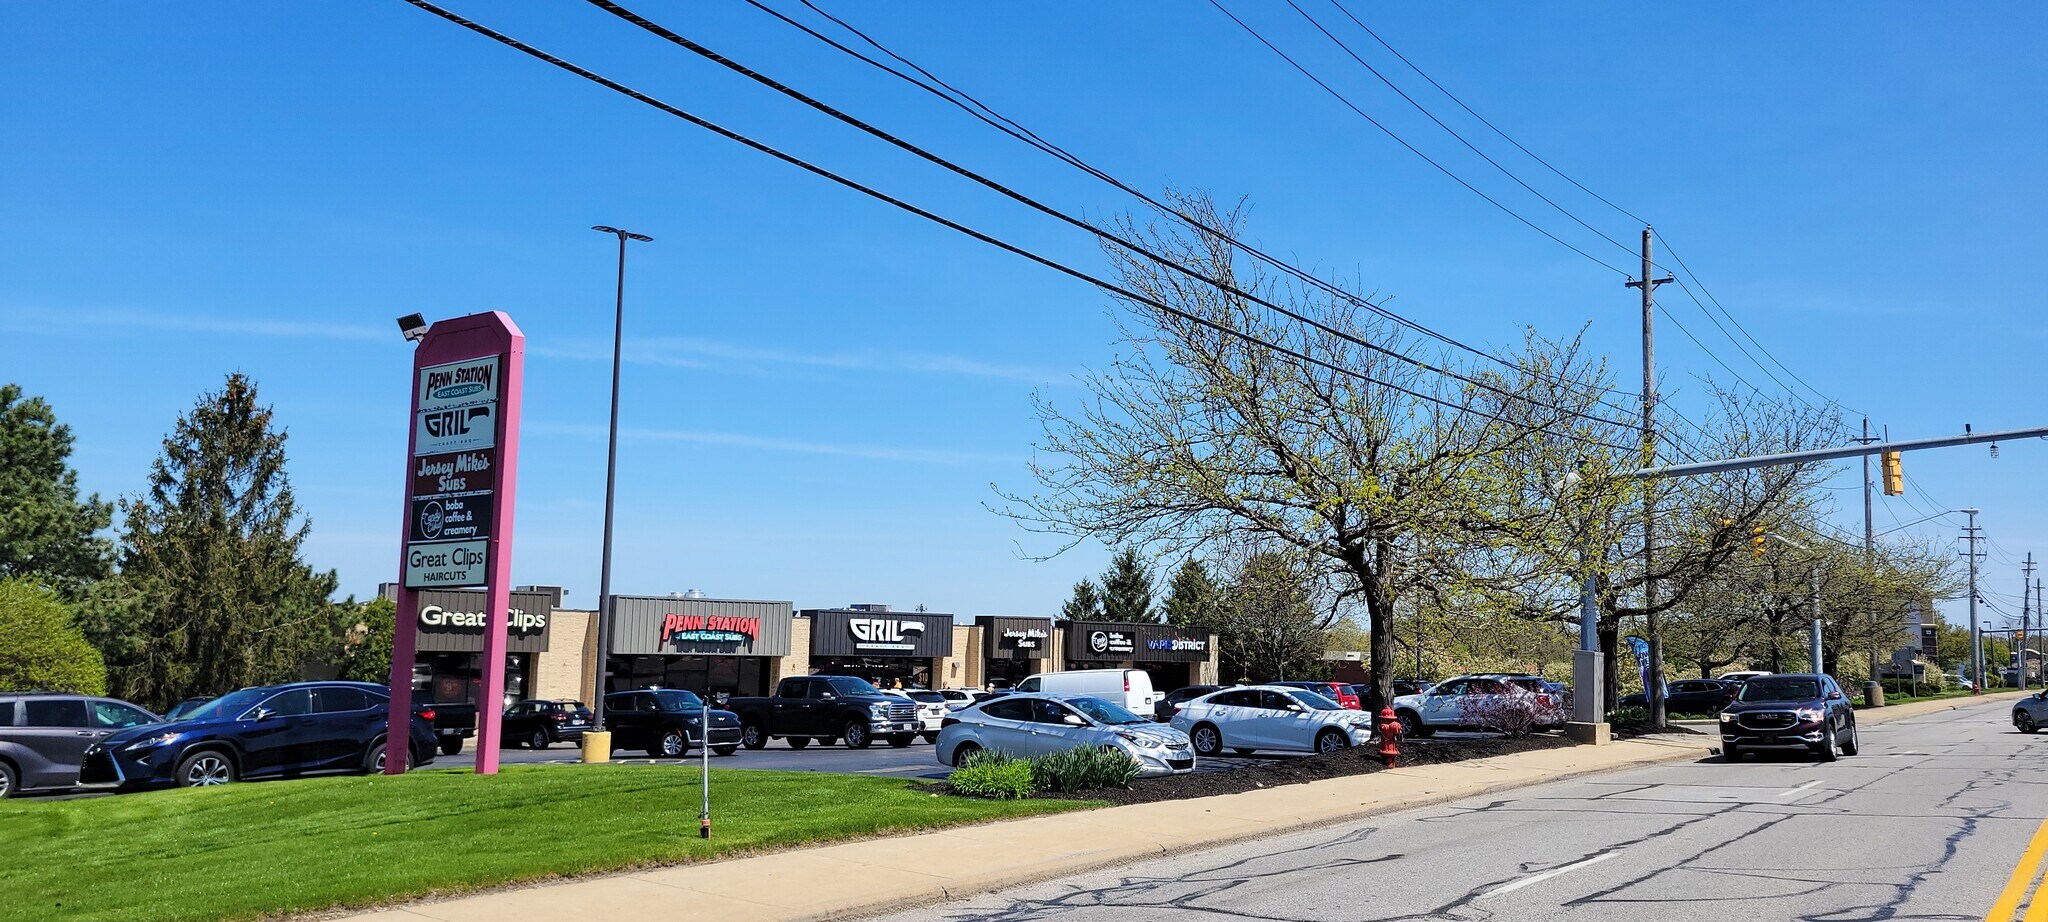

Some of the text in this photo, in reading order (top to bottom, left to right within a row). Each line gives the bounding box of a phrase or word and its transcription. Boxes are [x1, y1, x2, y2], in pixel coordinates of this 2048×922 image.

[426, 364, 493, 400] PENN STATION
[451, 387, 468, 395] COAST
[418, 453, 490, 478] Jersey Mike's
[446, 500, 463, 510] boba
[445, 511, 473, 523] coffee &
[444, 526, 477, 536] creamery
[410, 548, 483, 570] Great Clips
[423, 571, 466, 582] HAIRCUTS
[421, 605, 487, 627] Great
[663, 613, 760, 640] PENN STATION
[700, 632, 724, 640] COAST
[1003, 628, 1026, 640] Jersey
